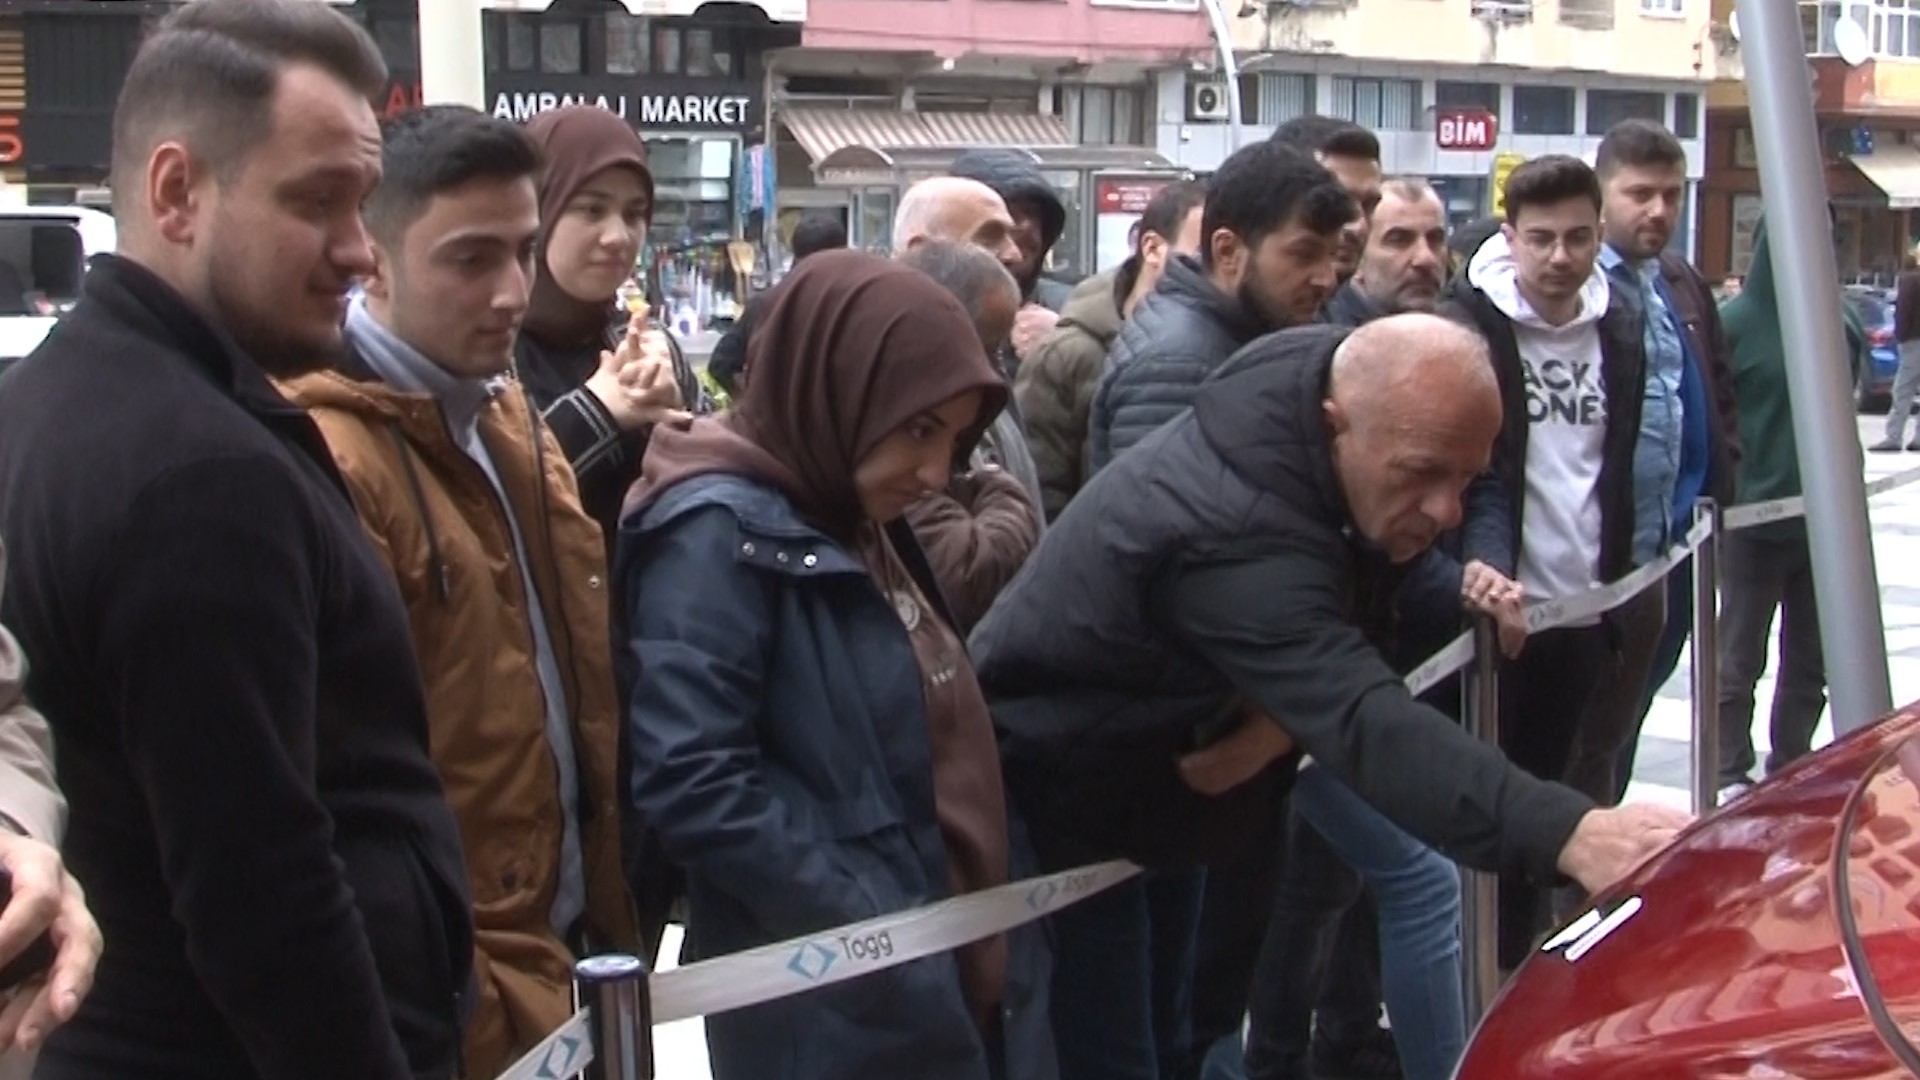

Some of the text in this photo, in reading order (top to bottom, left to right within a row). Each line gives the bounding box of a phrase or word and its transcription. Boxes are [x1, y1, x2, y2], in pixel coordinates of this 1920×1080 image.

[641, 95, 750, 123] MARKET
[1526, 392, 1608, 425] ONE
[838, 930, 894, 961] Togg
